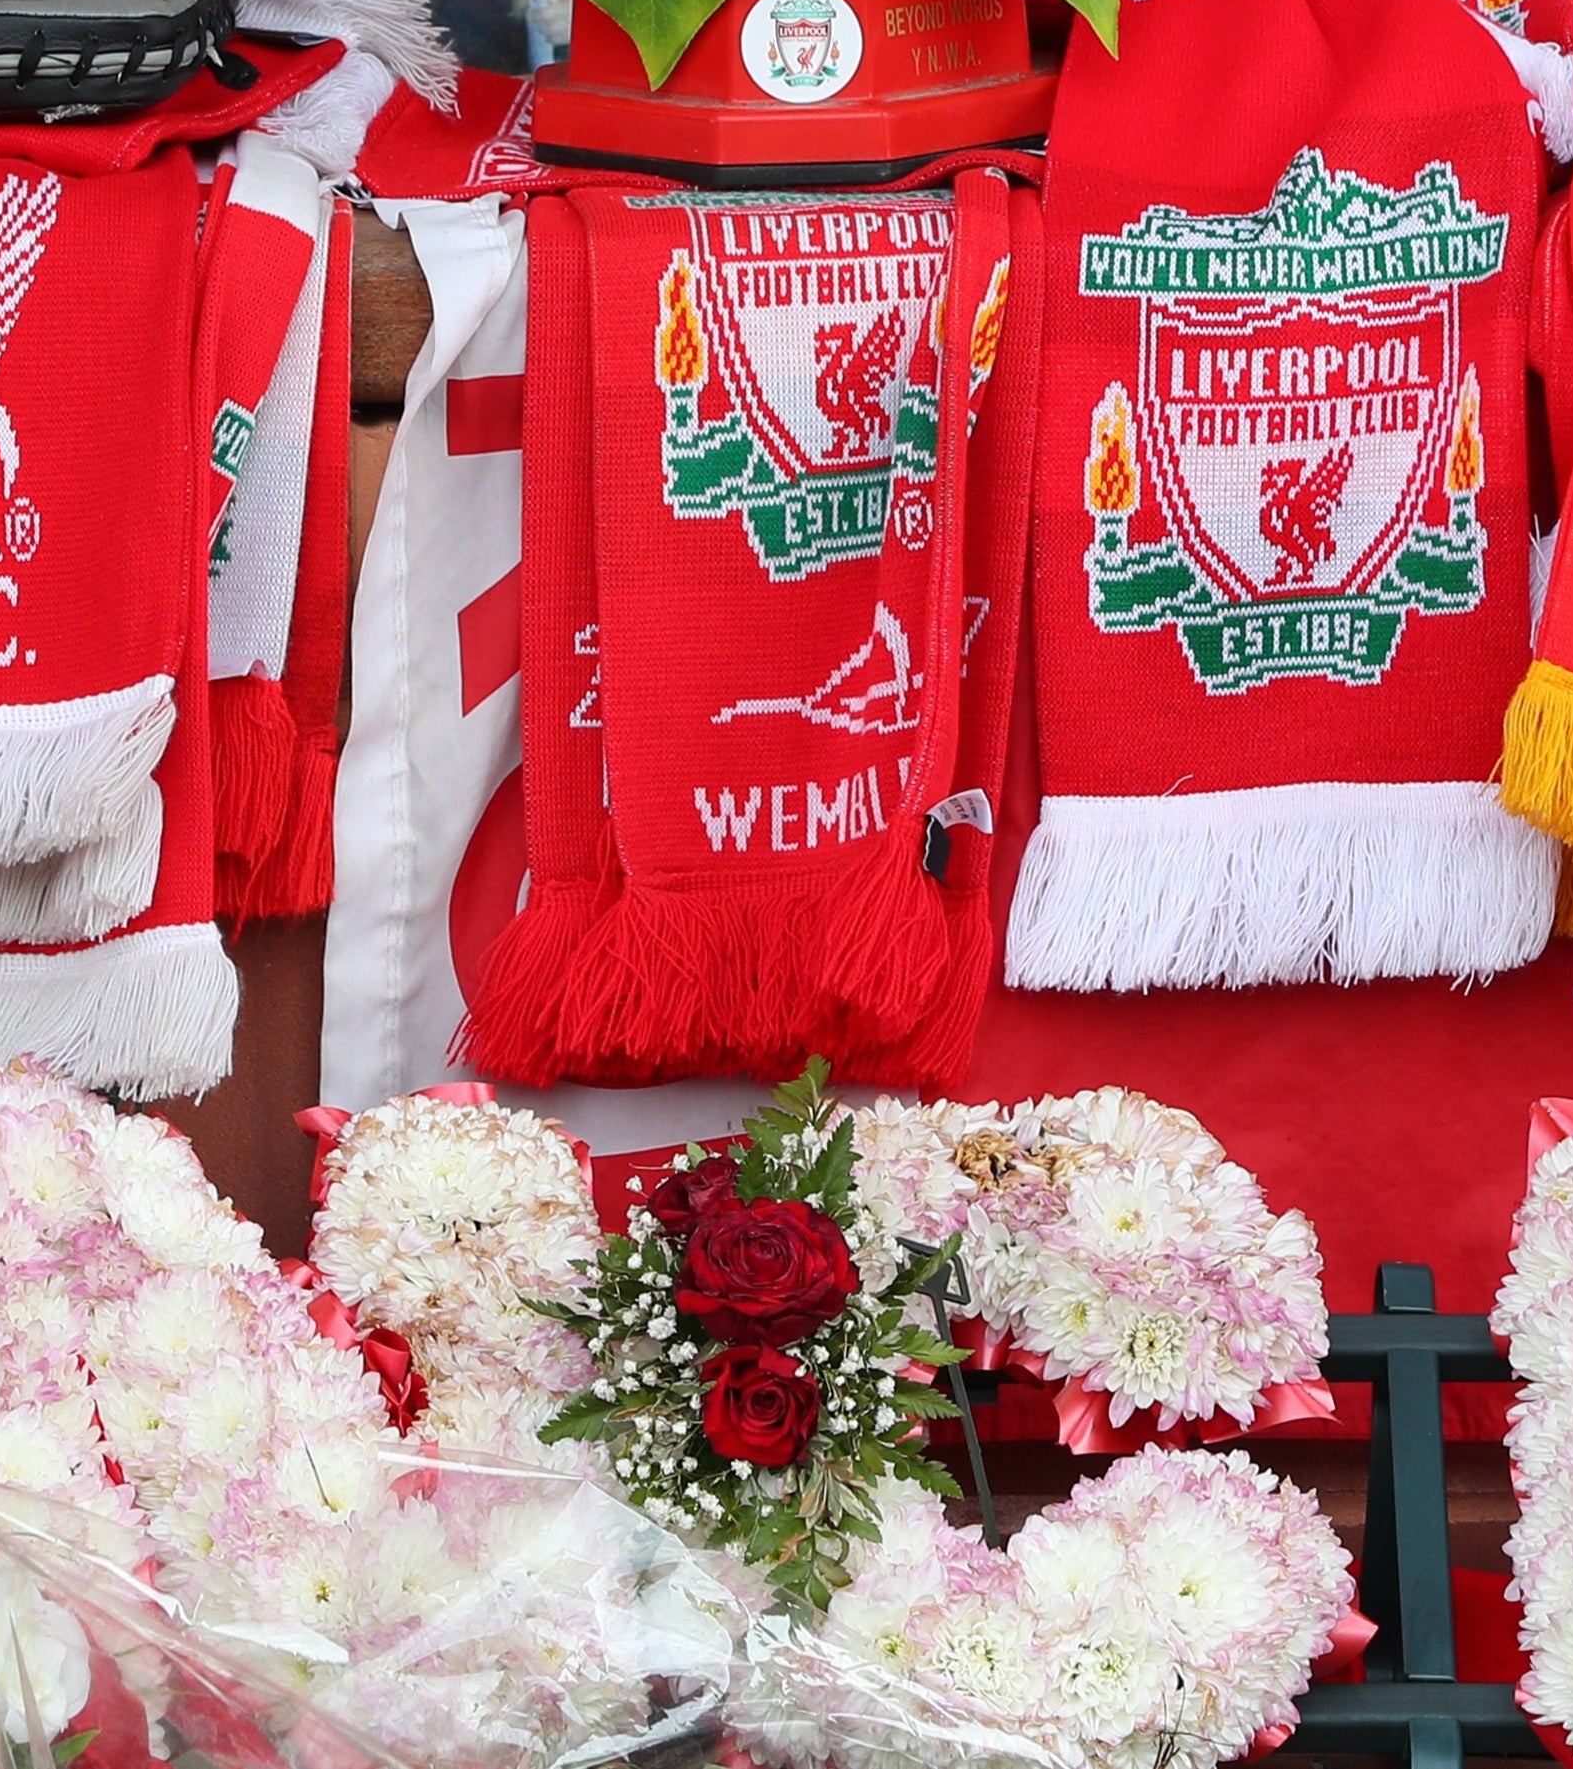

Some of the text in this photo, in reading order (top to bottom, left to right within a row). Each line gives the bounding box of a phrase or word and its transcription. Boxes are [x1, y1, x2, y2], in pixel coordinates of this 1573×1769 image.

[779, 27, 828, 38] LIVERPOOL
[885, 1, 946, 37] BEYOND
[720, 208, 953, 255] LIVERPOO
[738, 263, 890, 307] FOOTBALL
[1089, 228, 1503, 290] YOU'LL NEVER WALK ALONE
[1171, 336, 1430, 401] LIVERPOOL
[1180, 392, 1419, 446] FOOTBALL CLUB
[785, 489, 884, 545] EST.18
[1221, 609, 1370, 664] EST.1892
[694, 757, 912, 852] WEMBL
